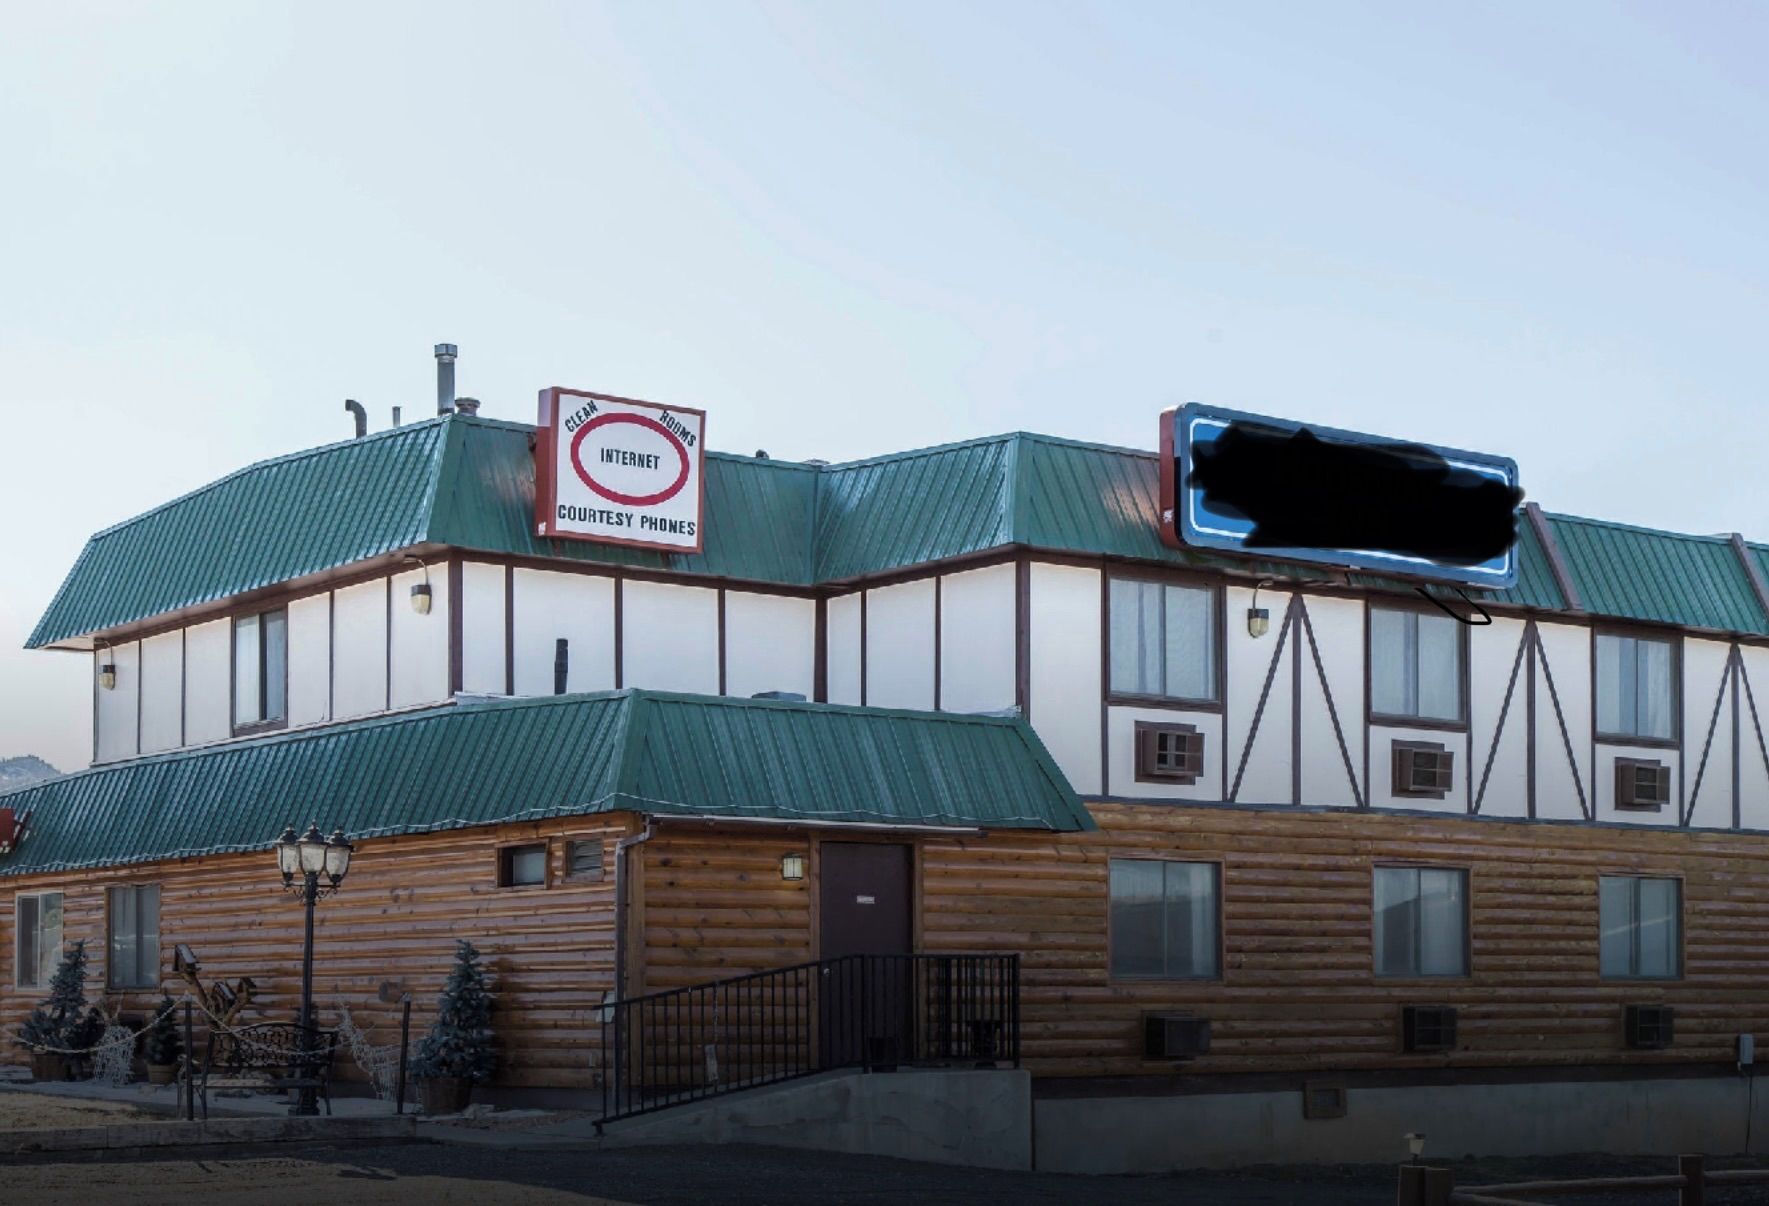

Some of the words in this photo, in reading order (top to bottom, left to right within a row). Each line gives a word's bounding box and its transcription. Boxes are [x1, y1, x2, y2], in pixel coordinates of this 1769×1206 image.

[564, 400, 598, 433] CLEAN
[659, 410, 696, 446] ROOMS
[600, 448, 660, 470] INTERNET
[558, 504, 633, 528] COURTESY
[640, 515, 696, 536] PHONES
